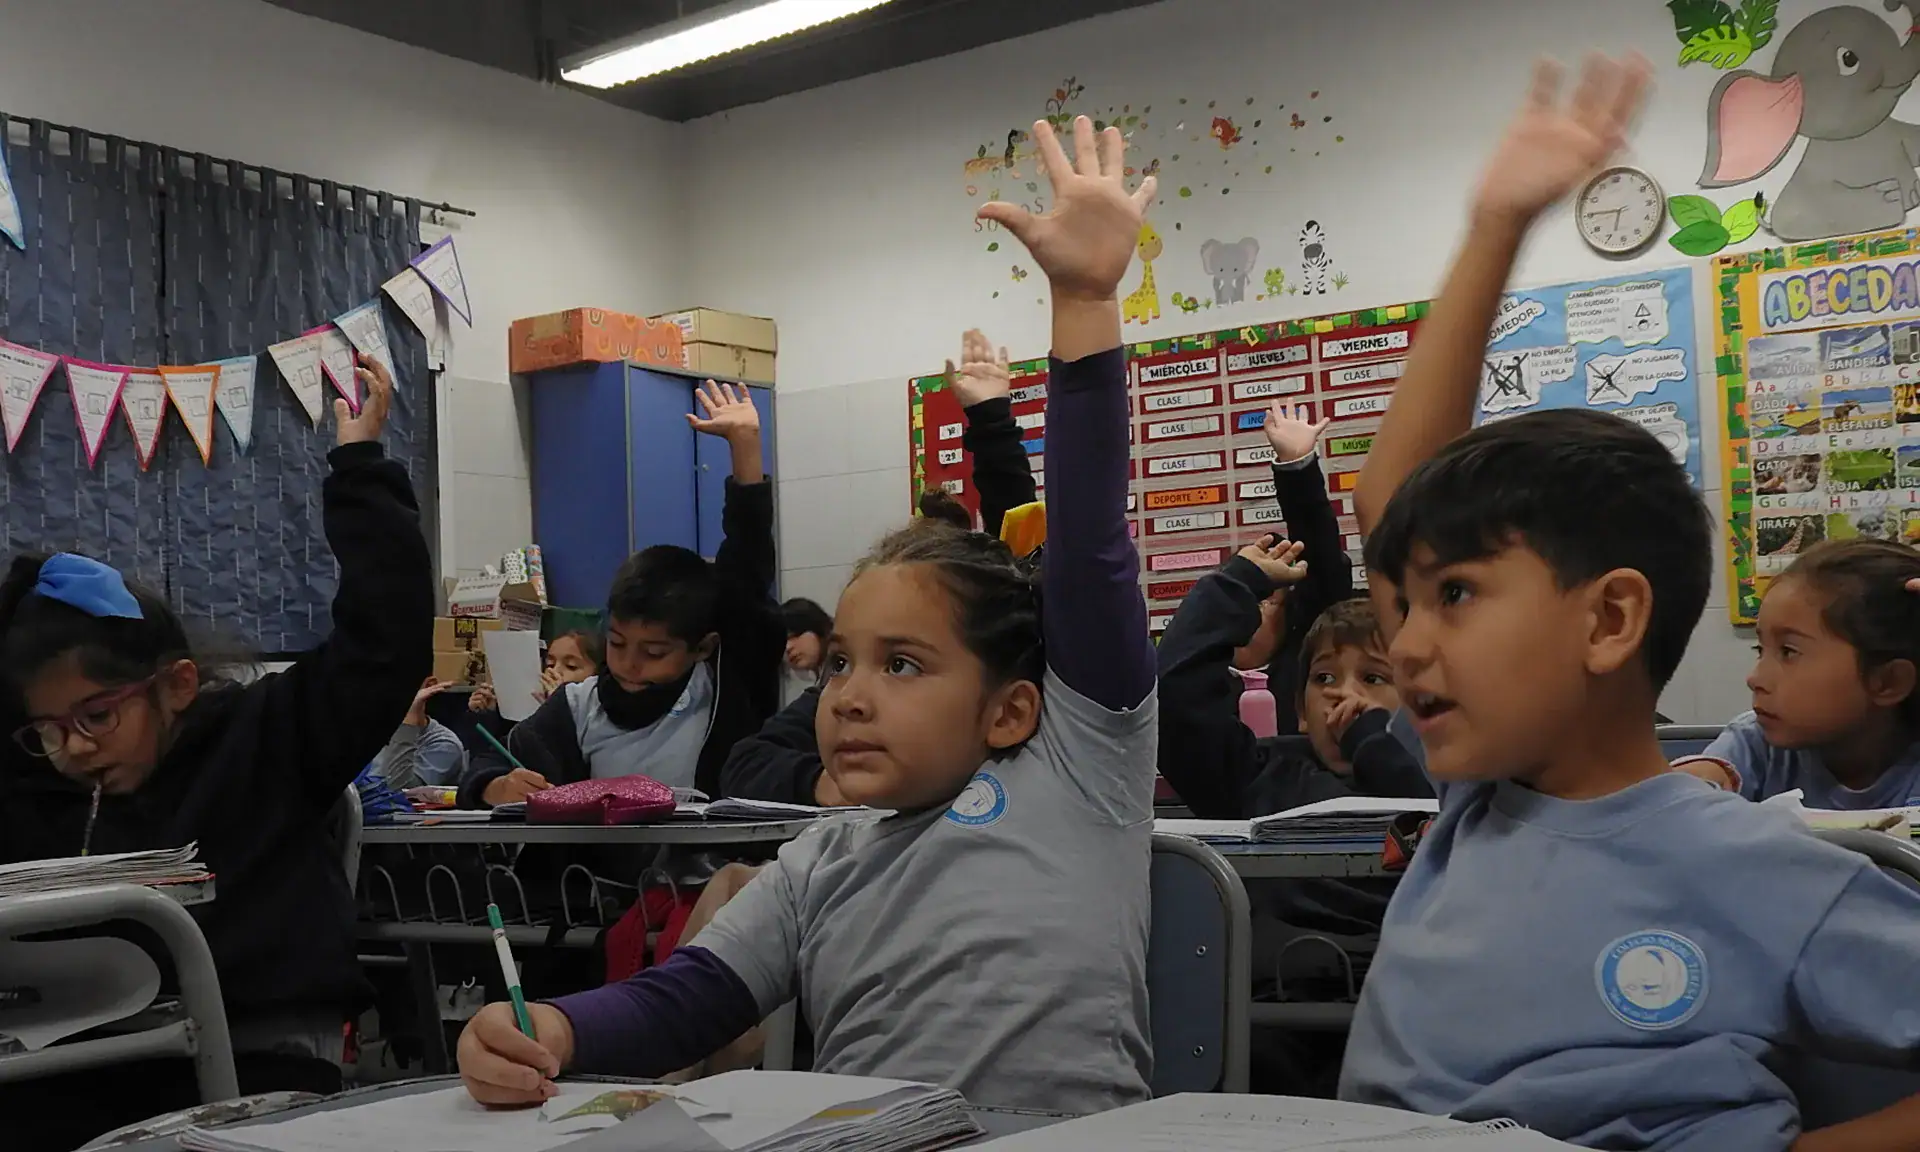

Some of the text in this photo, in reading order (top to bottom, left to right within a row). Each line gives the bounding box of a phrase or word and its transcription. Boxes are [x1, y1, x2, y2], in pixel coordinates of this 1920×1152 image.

[1625, 282, 1661, 292] COMEDOR
[1764, 260, 1920, 327] ABECEDA
[1584, 298, 1614, 308] CUIDADO
[1489, 307, 1538, 339] OMEDOR:
[1341, 337, 1389, 352] VIERNES
[1249, 351, 1285, 366] JUEVES
[1644, 354, 1680, 363] JUGAMOS
[1827, 355, 1887, 370] BANDERA
[1343, 369, 1371, 381] CLASE
[1656, 370, 1684, 379] COMIDA
[1898, 366, 1909, 379] C
[1755, 381, 1765, 393] A
[1824, 375, 1834, 387] B
[1246, 383, 1272, 395] CLASE
[1157, 395, 1182, 406] CLASE
[1348, 400, 1377, 412] CLASE
[1754, 398, 1790, 411] DADO
[1248, 415, 1264, 425] ING
[1828, 419, 1888, 432] ELEFANTE
[1161, 423, 1186, 435] CLASE
[1342, 438, 1372, 451] MÚSIC
[1757, 441, 1768, 453] D
[1776, 441, 1784, 452] d
[1829, 435, 1839, 447] E
[1846, 438, 1853, 446] e
[1249, 450, 1276, 461] CLASE
[1161, 459, 1187, 470] CLASE
[1757, 460, 1789, 472] GATO
[1900, 478, 1920, 488] ISL
[1254, 485, 1277, 495] CLAS
[1154, 493, 1192, 505] DEPORTE
[1759, 497, 1771, 508] G
[1830, 496, 1841, 509] H
[1850, 497, 1858, 506] h
[1256, 510, 1282, 520] CLASE
[1166, 518, 1191, 529] CLASE
[1758, 518, 1797, 530] JIRAFA
[1156, 553, 1213, 568] BIBLIOTECA
[1153, 583, 1191, 596] COMPUT
